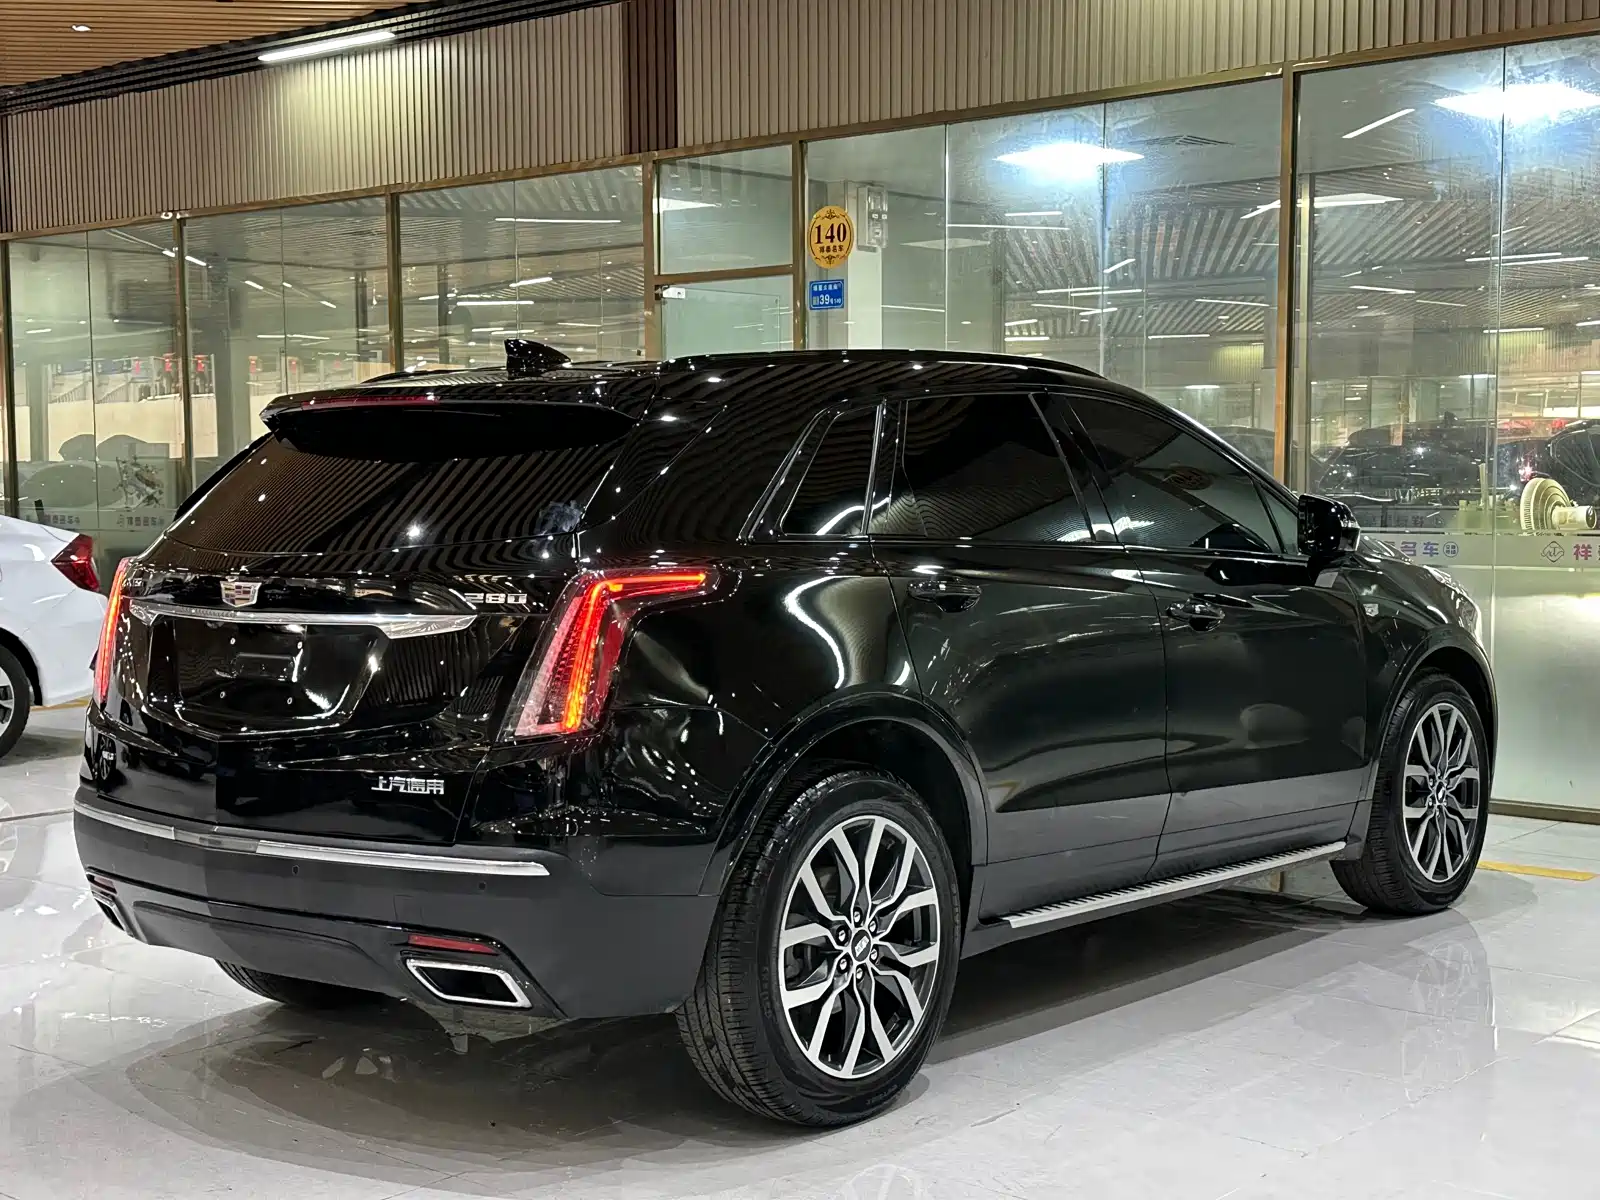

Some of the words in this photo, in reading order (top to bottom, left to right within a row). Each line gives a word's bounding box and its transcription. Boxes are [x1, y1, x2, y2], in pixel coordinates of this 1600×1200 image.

[814, 223, 847, 244] 140
[1573, 543, 1600, 561] 祥
[371, 776, 445, 795] 上汽通用
